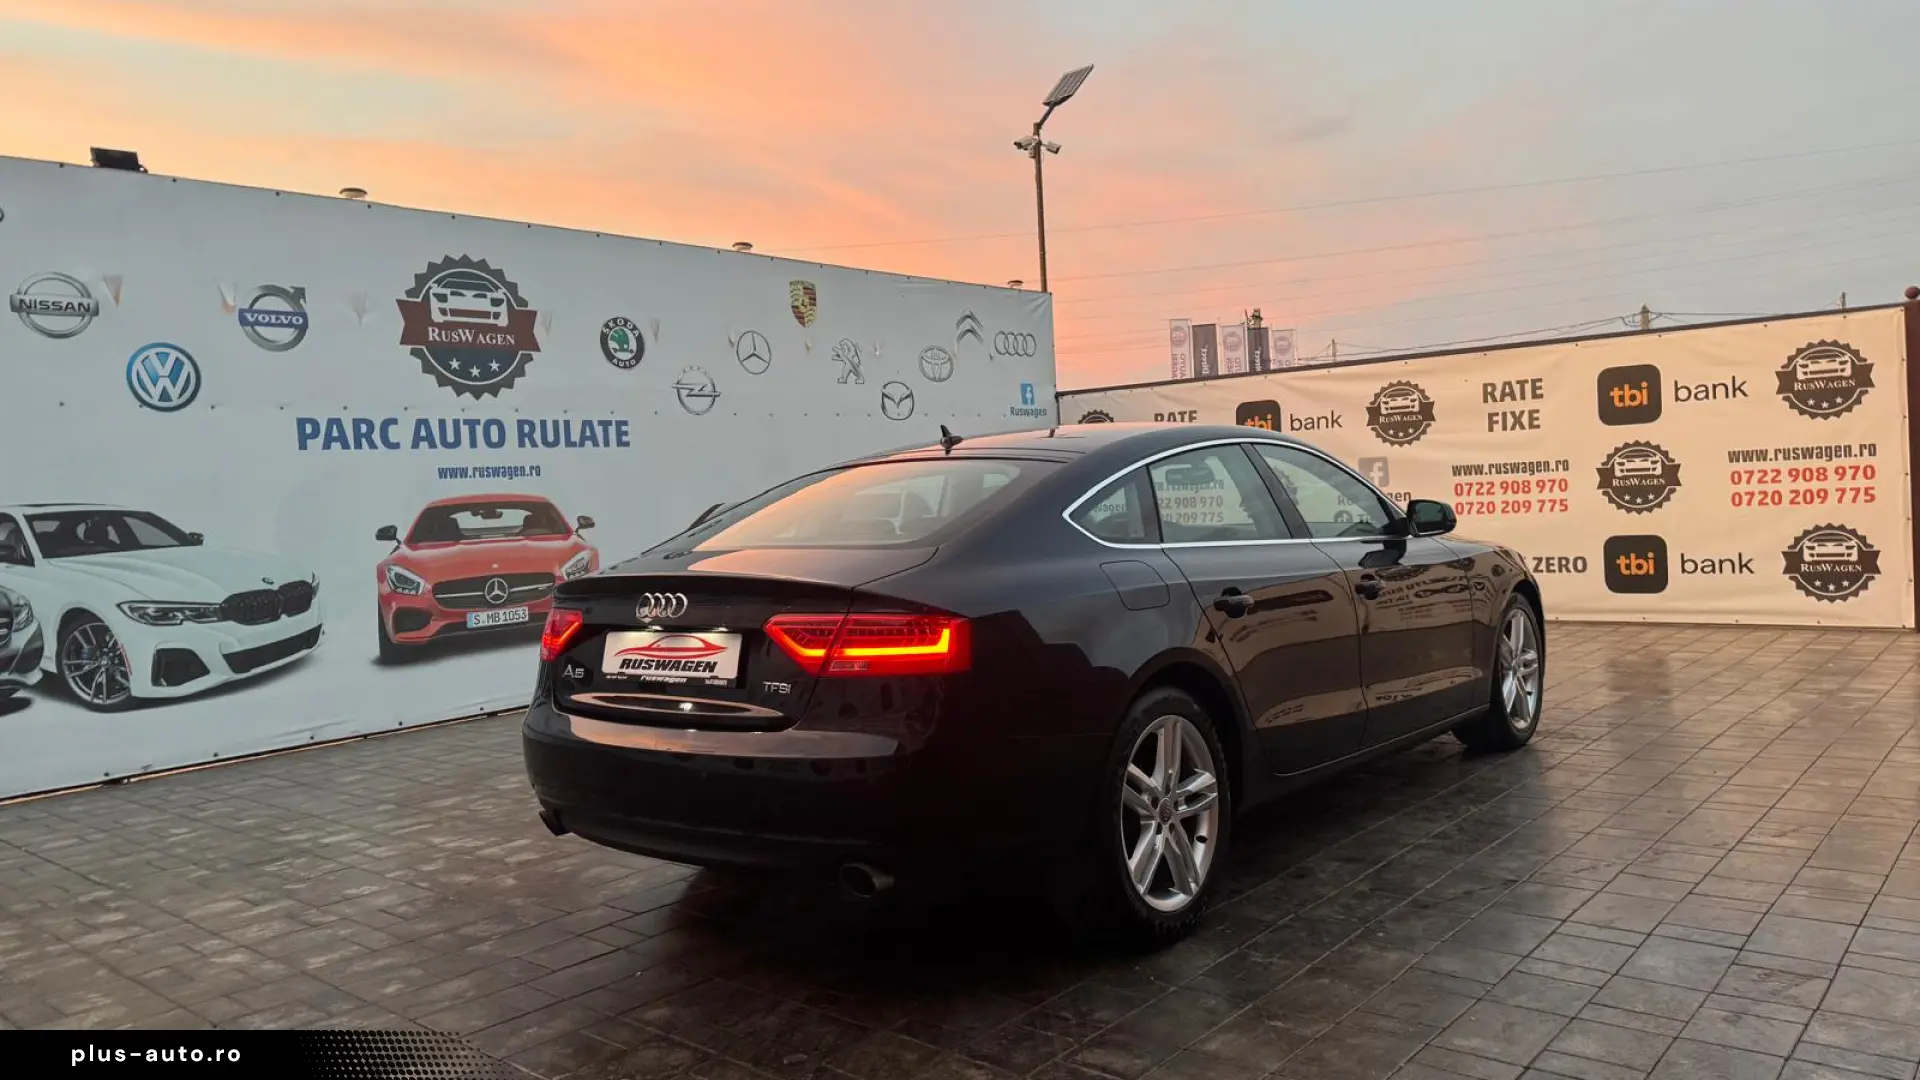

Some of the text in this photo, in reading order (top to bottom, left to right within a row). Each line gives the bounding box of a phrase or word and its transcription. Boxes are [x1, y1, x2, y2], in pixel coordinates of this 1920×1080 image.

[19, 298, 91, 313] NISSAN
[244, 312, 304, 326] VOLVO
[1482, 378, 1544, 403] RATE
[1610, 375, 1748, 408] tbi bank
[1290, 410, 1343, 432] bank
[1487, 409, 1541, 432] FIXE
[295, 417, 630, 450] PARC AUTO RULATE
[1728, 443, 1877, 463] www.ruswagen.ro
[437, 465, 541, 481] www.ruswagen.ro
[1451, 459, 1569, 476] www.ruswagen.ro
[1730, 464, 1875, 485] 0722 908 970
[1454, 478, 1568, 496] 0722 908 970
[1174, 496, 1197, 509] 908
[1200, 495, 1224, 508] 970
[1731, 486, 1876, 507] 0720 209 775
[1455, 498, 1568, 515] 0720 209 775
[1200, 511, 1224, 523] 775
[1532, 556, 1587, 574] ZERO
[1616, 552, 1755, 575] tbi bank
[502, 608, 527, 621] 1053
[562, 664, 585, 679] A5
[619, 658, 718, 673] RUSWAGEN
